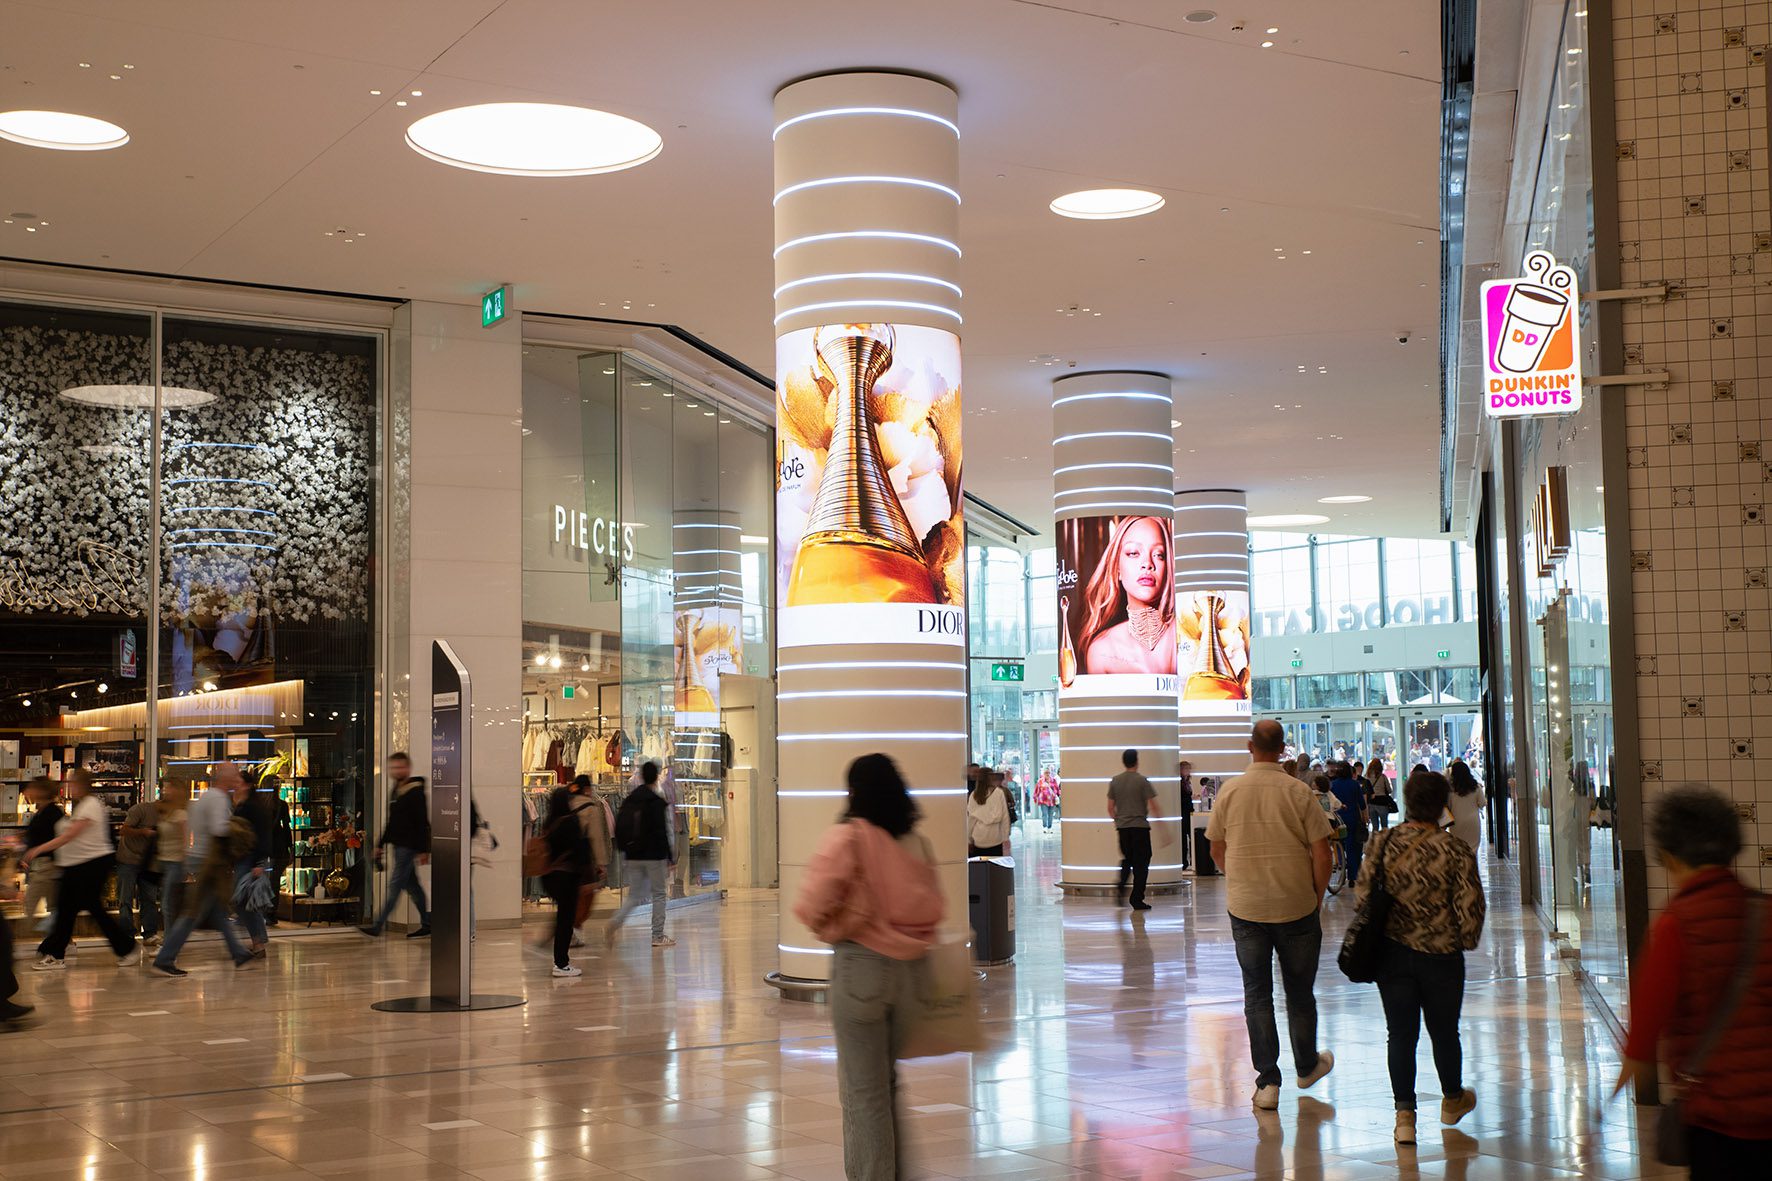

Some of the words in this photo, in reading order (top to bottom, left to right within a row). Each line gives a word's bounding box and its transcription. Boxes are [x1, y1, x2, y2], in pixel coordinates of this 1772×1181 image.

[1511, 329, 1538, 346] DD
[1490, 373, 1575, 393] DUNKIN'
[1491, 390, 1572, 408] DONUTS
[555, 504, 634, 561] PIECES
[917, 609, 963, 635] DIOR
